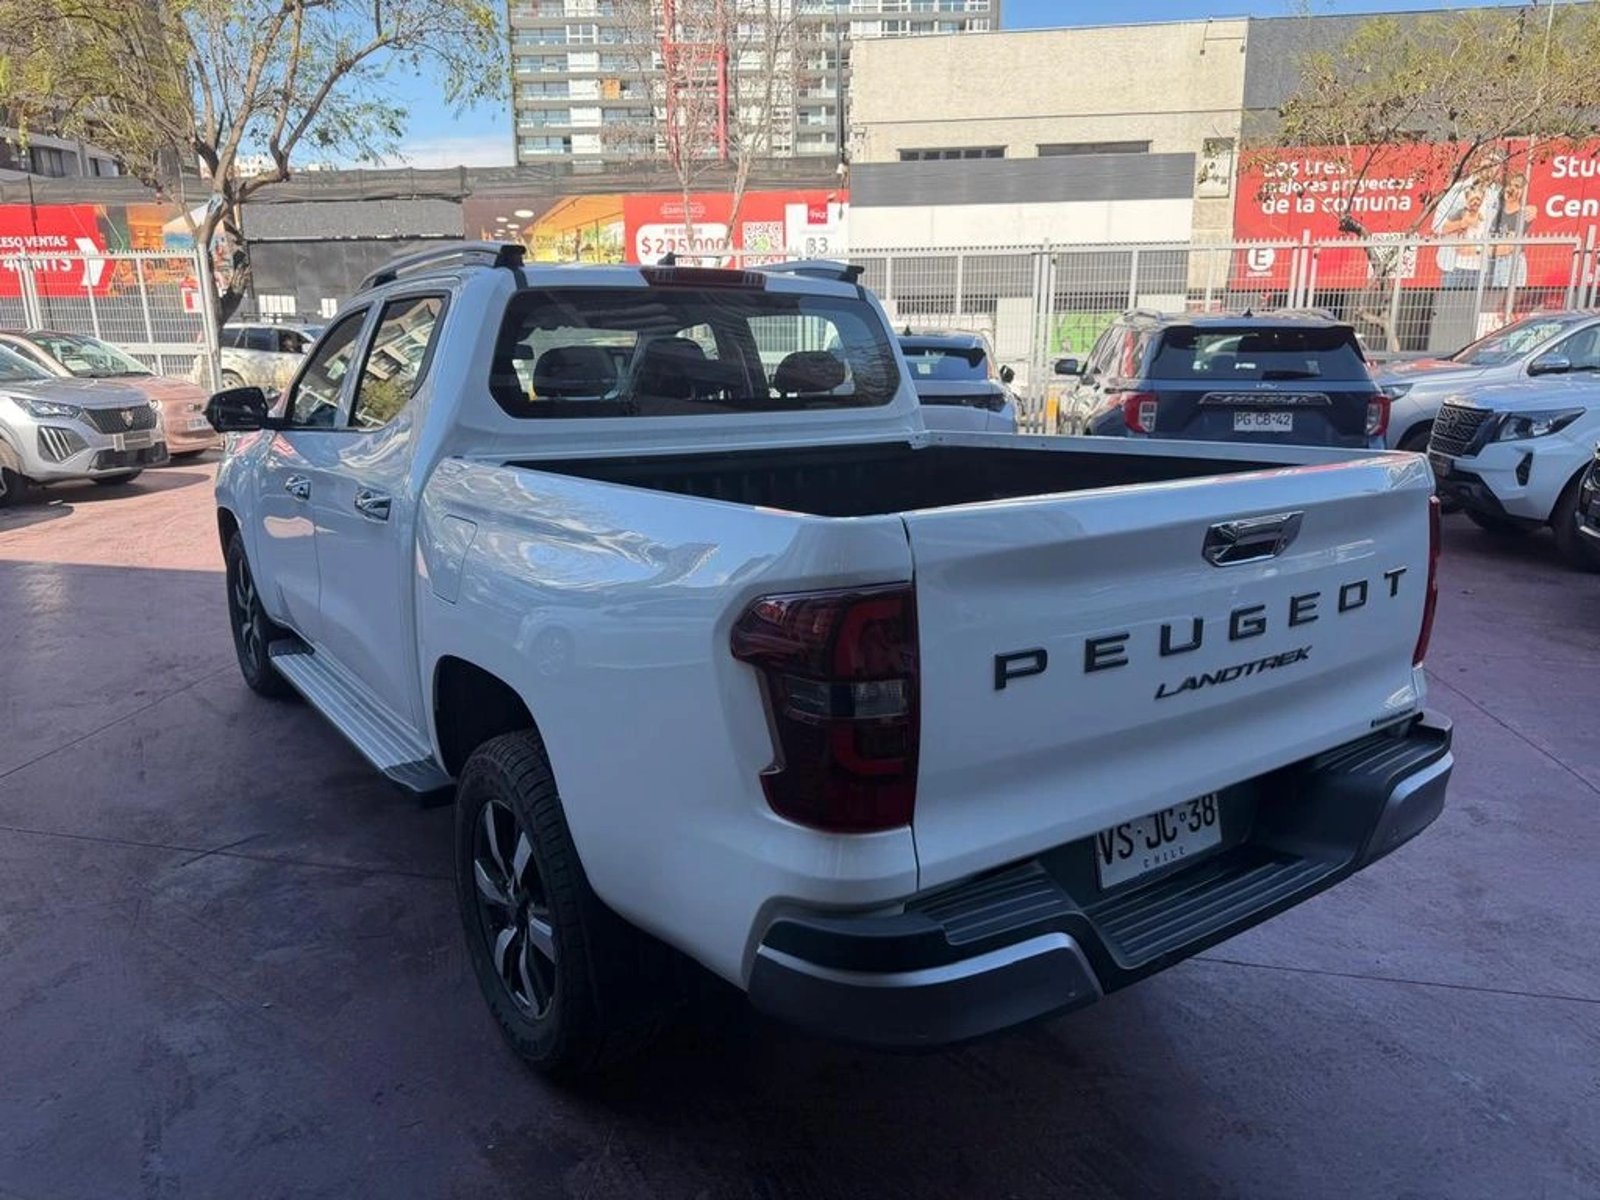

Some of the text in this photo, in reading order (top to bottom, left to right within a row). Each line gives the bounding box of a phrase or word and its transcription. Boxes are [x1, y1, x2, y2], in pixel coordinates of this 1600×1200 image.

[1551, 155, 1600, 178] Stu
[1261, 192, 1413, 215] de la comuna
[0, 234, 68, 248] ESO VENTAS
[994, 567, 1407, 691] PEUGEOT
[1154, 646, 1313, 700] LANDTREK
